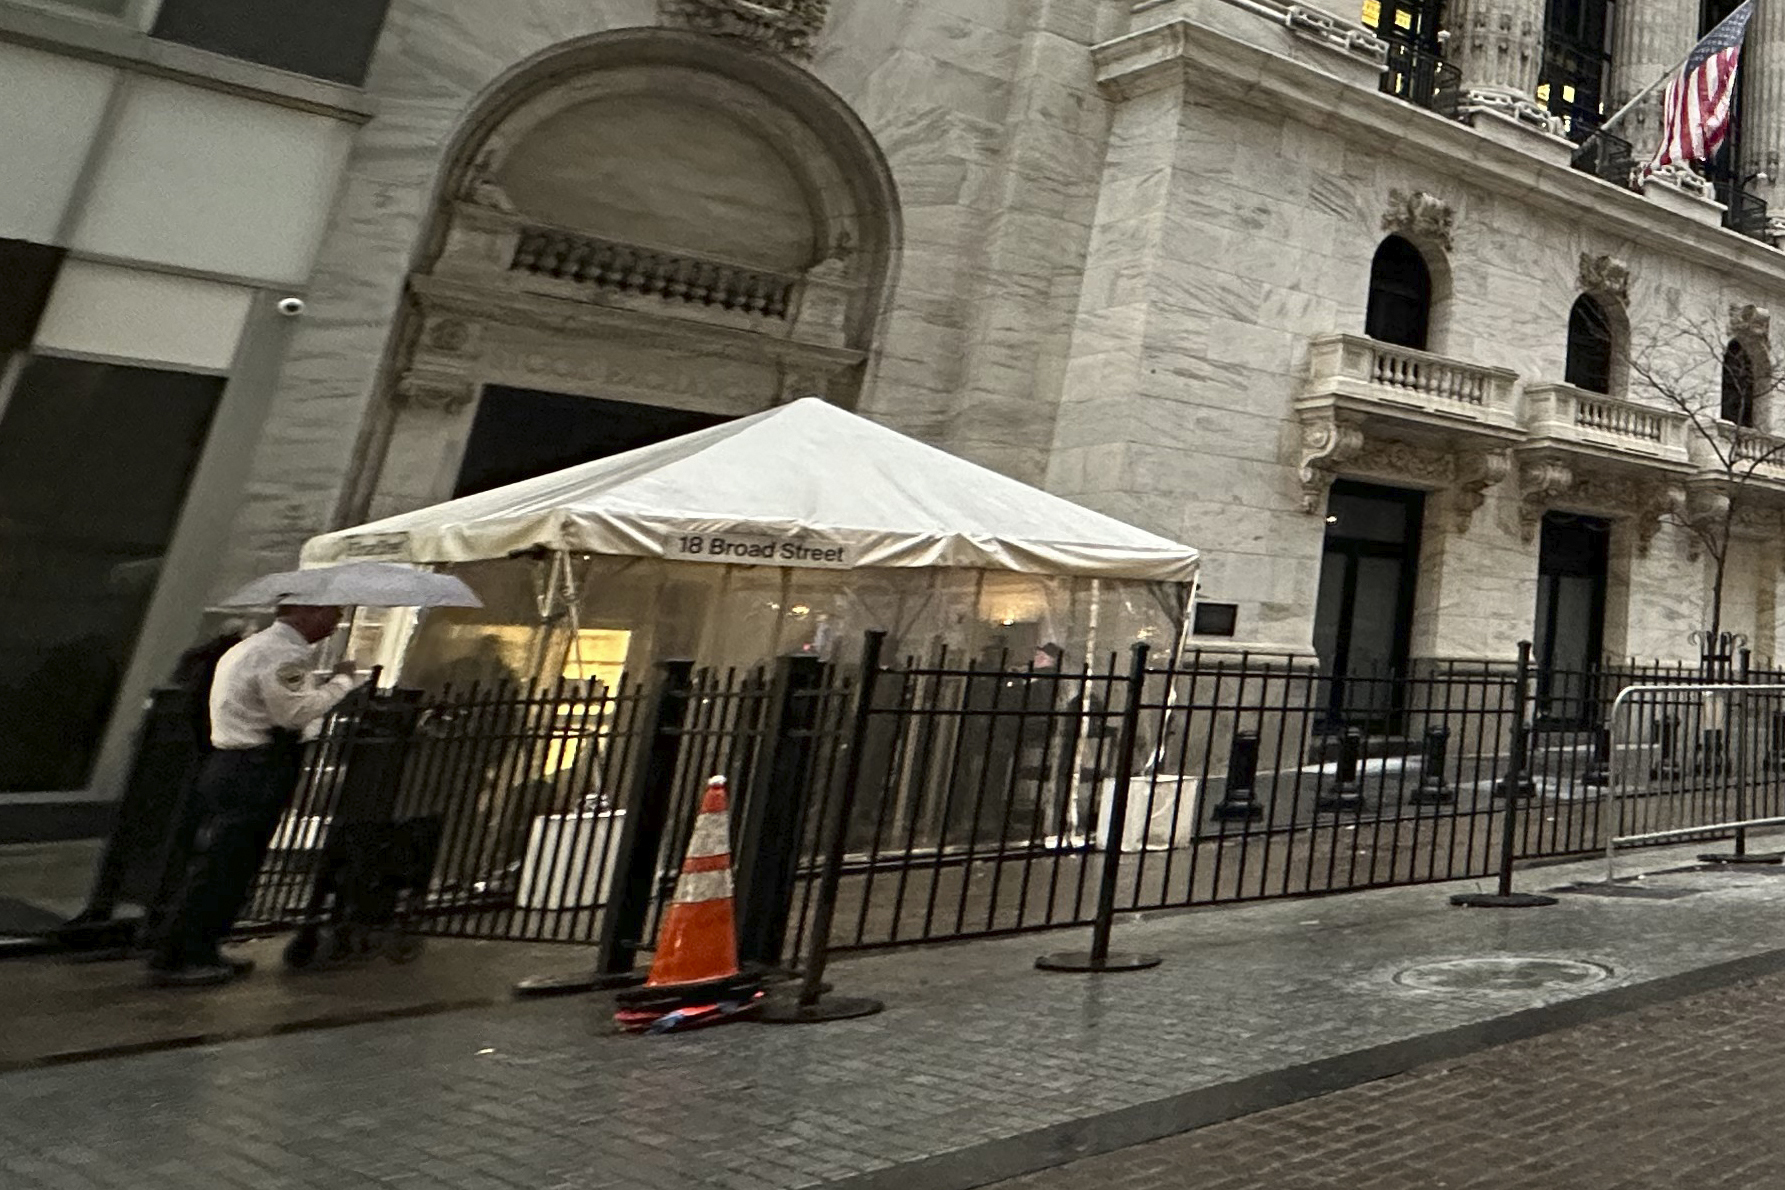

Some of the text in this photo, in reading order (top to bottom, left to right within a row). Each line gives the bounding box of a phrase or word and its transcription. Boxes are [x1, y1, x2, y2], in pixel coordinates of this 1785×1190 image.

[678, 536, 844, 562] 18 Broad Street
